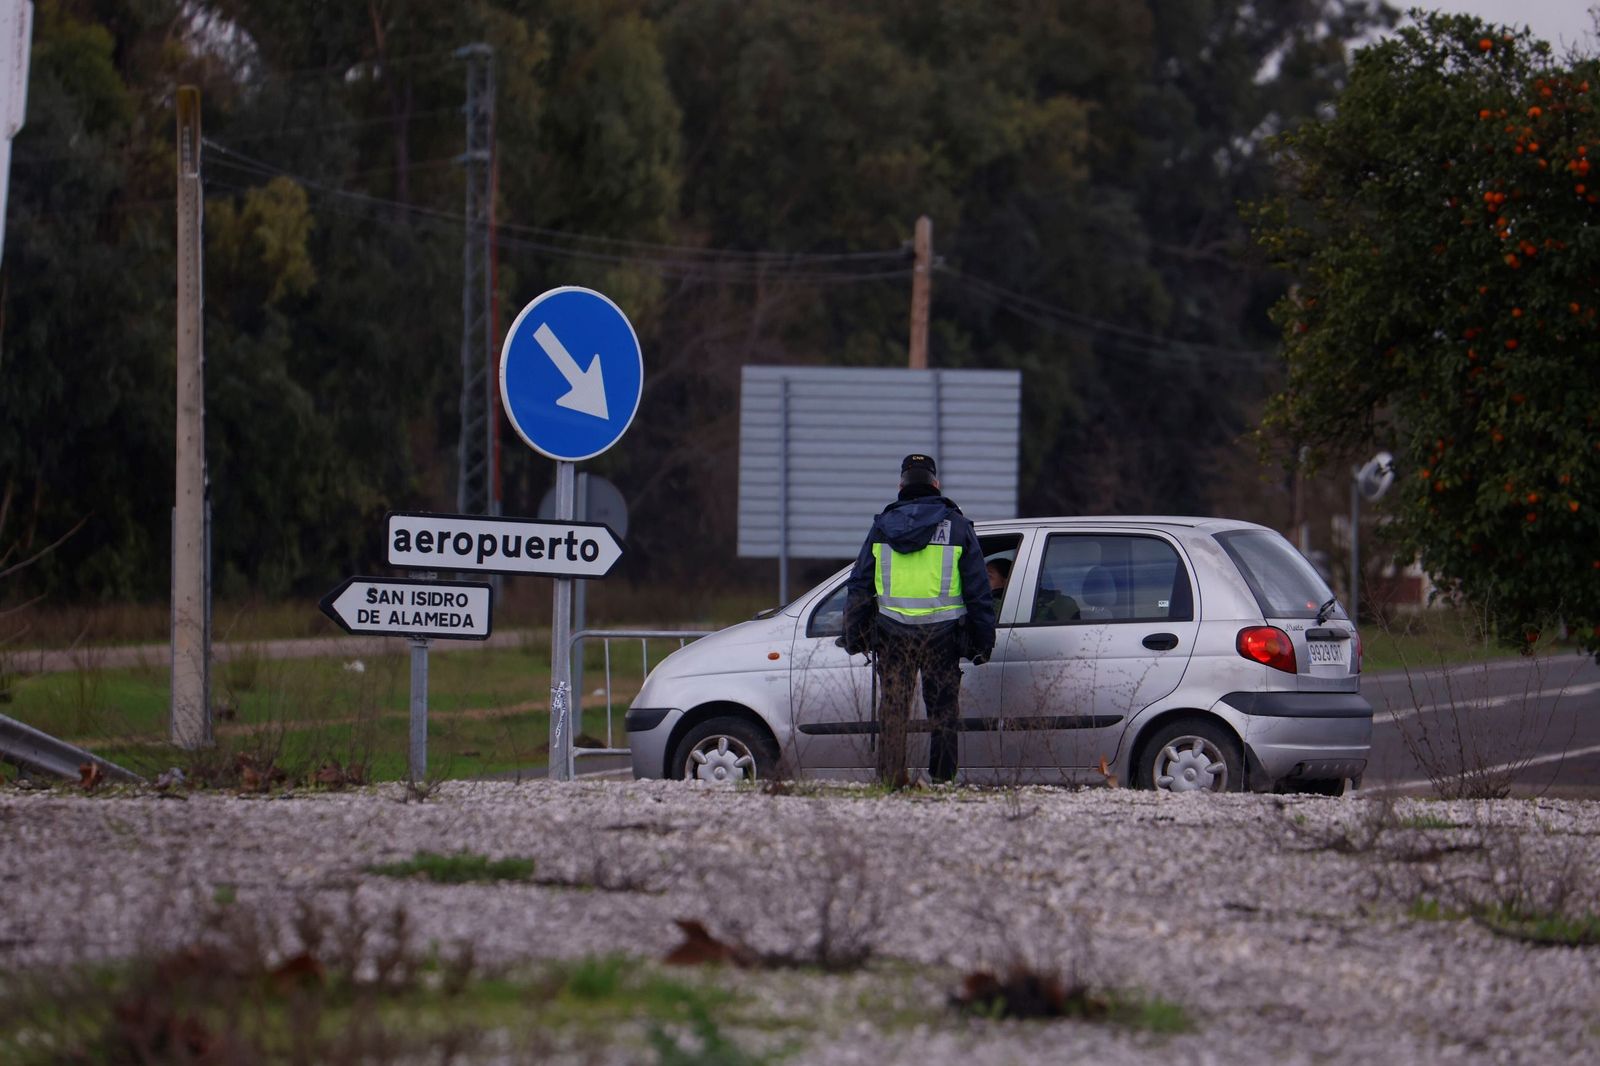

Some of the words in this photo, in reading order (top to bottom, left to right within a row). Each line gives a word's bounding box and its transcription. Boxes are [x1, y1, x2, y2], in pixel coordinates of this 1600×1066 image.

[393, 527, 599, 564] aeropuerto
[366, 587, 404, 605] SAN
[411, 590, 469, 608] ISIDRO
[358, 609, 380, 625] DE
[388, 611, 475, 628] ALAMEDA
[1310, 644, 1330, 661] 9929
